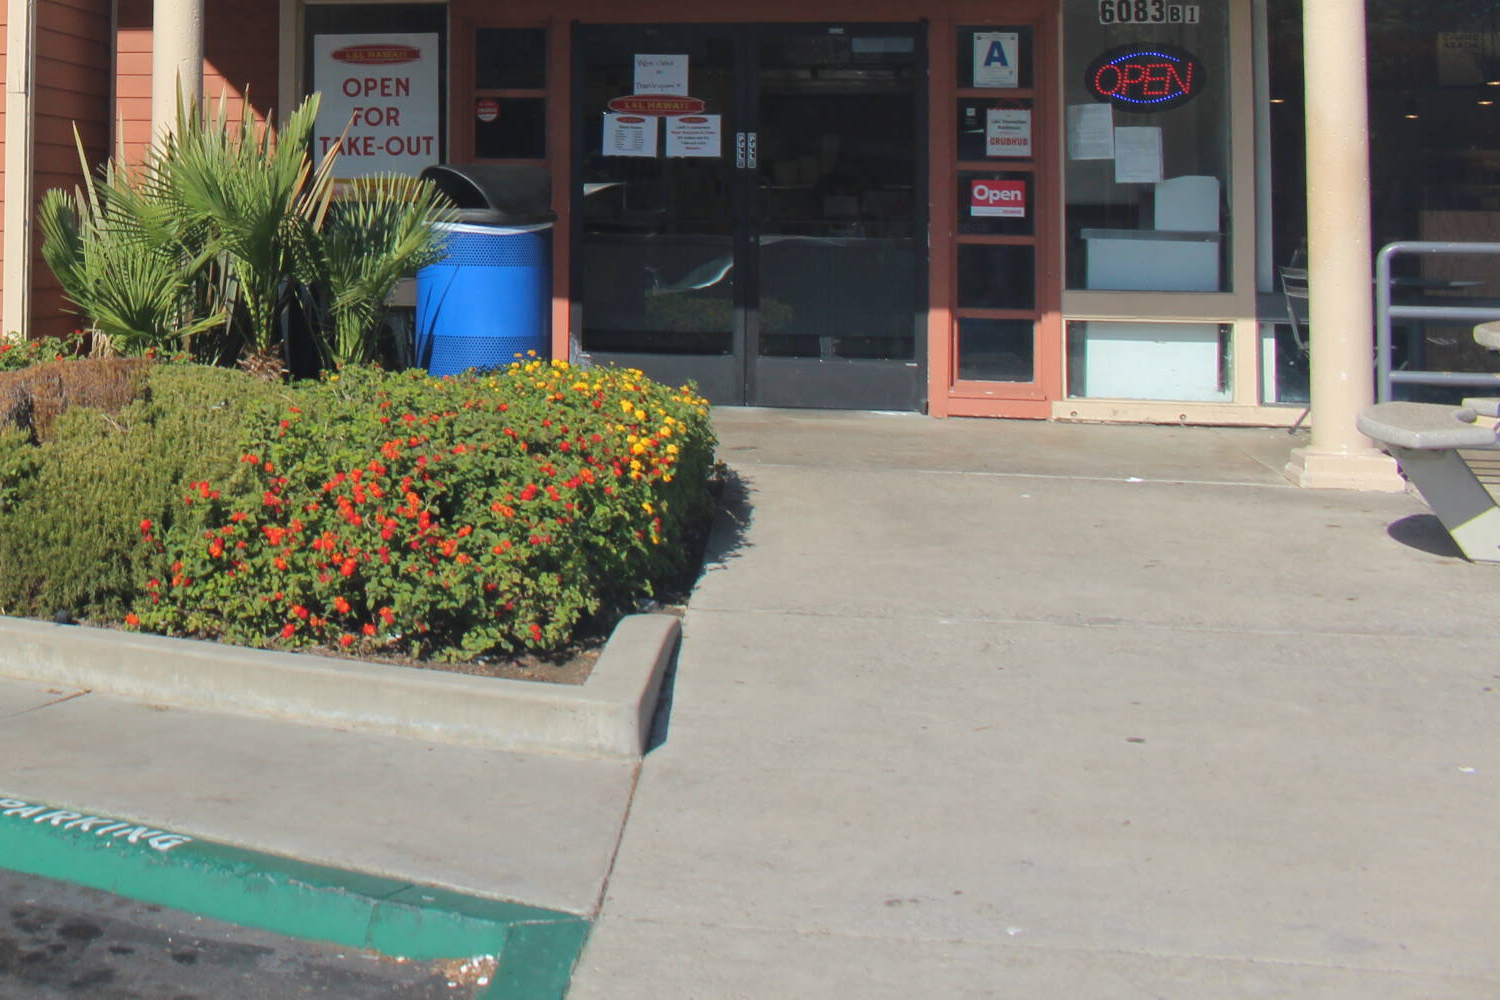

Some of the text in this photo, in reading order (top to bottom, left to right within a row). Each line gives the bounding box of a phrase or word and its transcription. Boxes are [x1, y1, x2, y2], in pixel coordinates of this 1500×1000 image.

[1100, 0, 1165, 23] 6083
[984, 41, 1008, 67] A
[342, 77, 410, 97] OPEN
[1095, 62, 1193, 95] OPEN
[352, 107, 400, 127] FOR
[319, 136, 434, 156] TAKE-OUT
[973, 185, 1022, 205] Open
